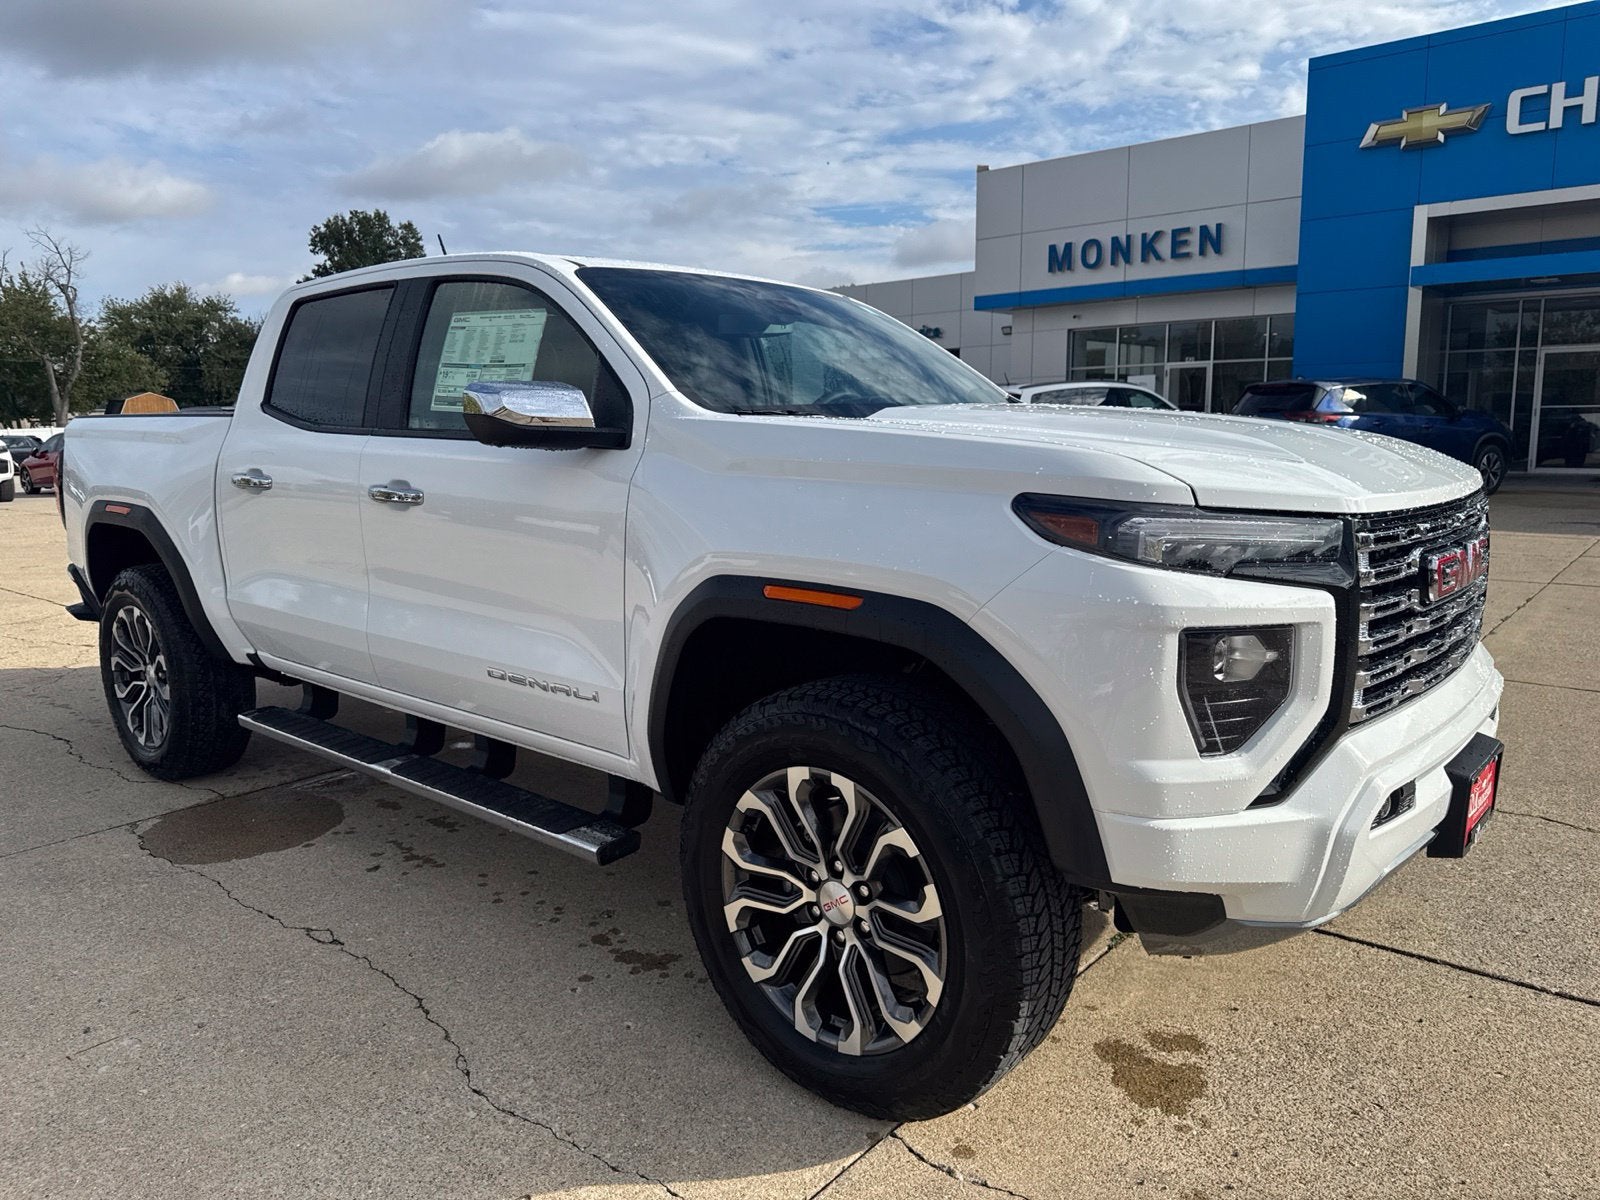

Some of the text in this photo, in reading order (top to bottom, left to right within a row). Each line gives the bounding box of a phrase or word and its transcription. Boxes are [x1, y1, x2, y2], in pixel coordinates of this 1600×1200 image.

[1506, 76, 1599, 135] CH
[1048, 223, 1223, 274] MONKEN
[1437, 538, 1488, 597] GMC
[487, 666, 600, 703] DENALI
[823, 895, 848, 912] GMC
